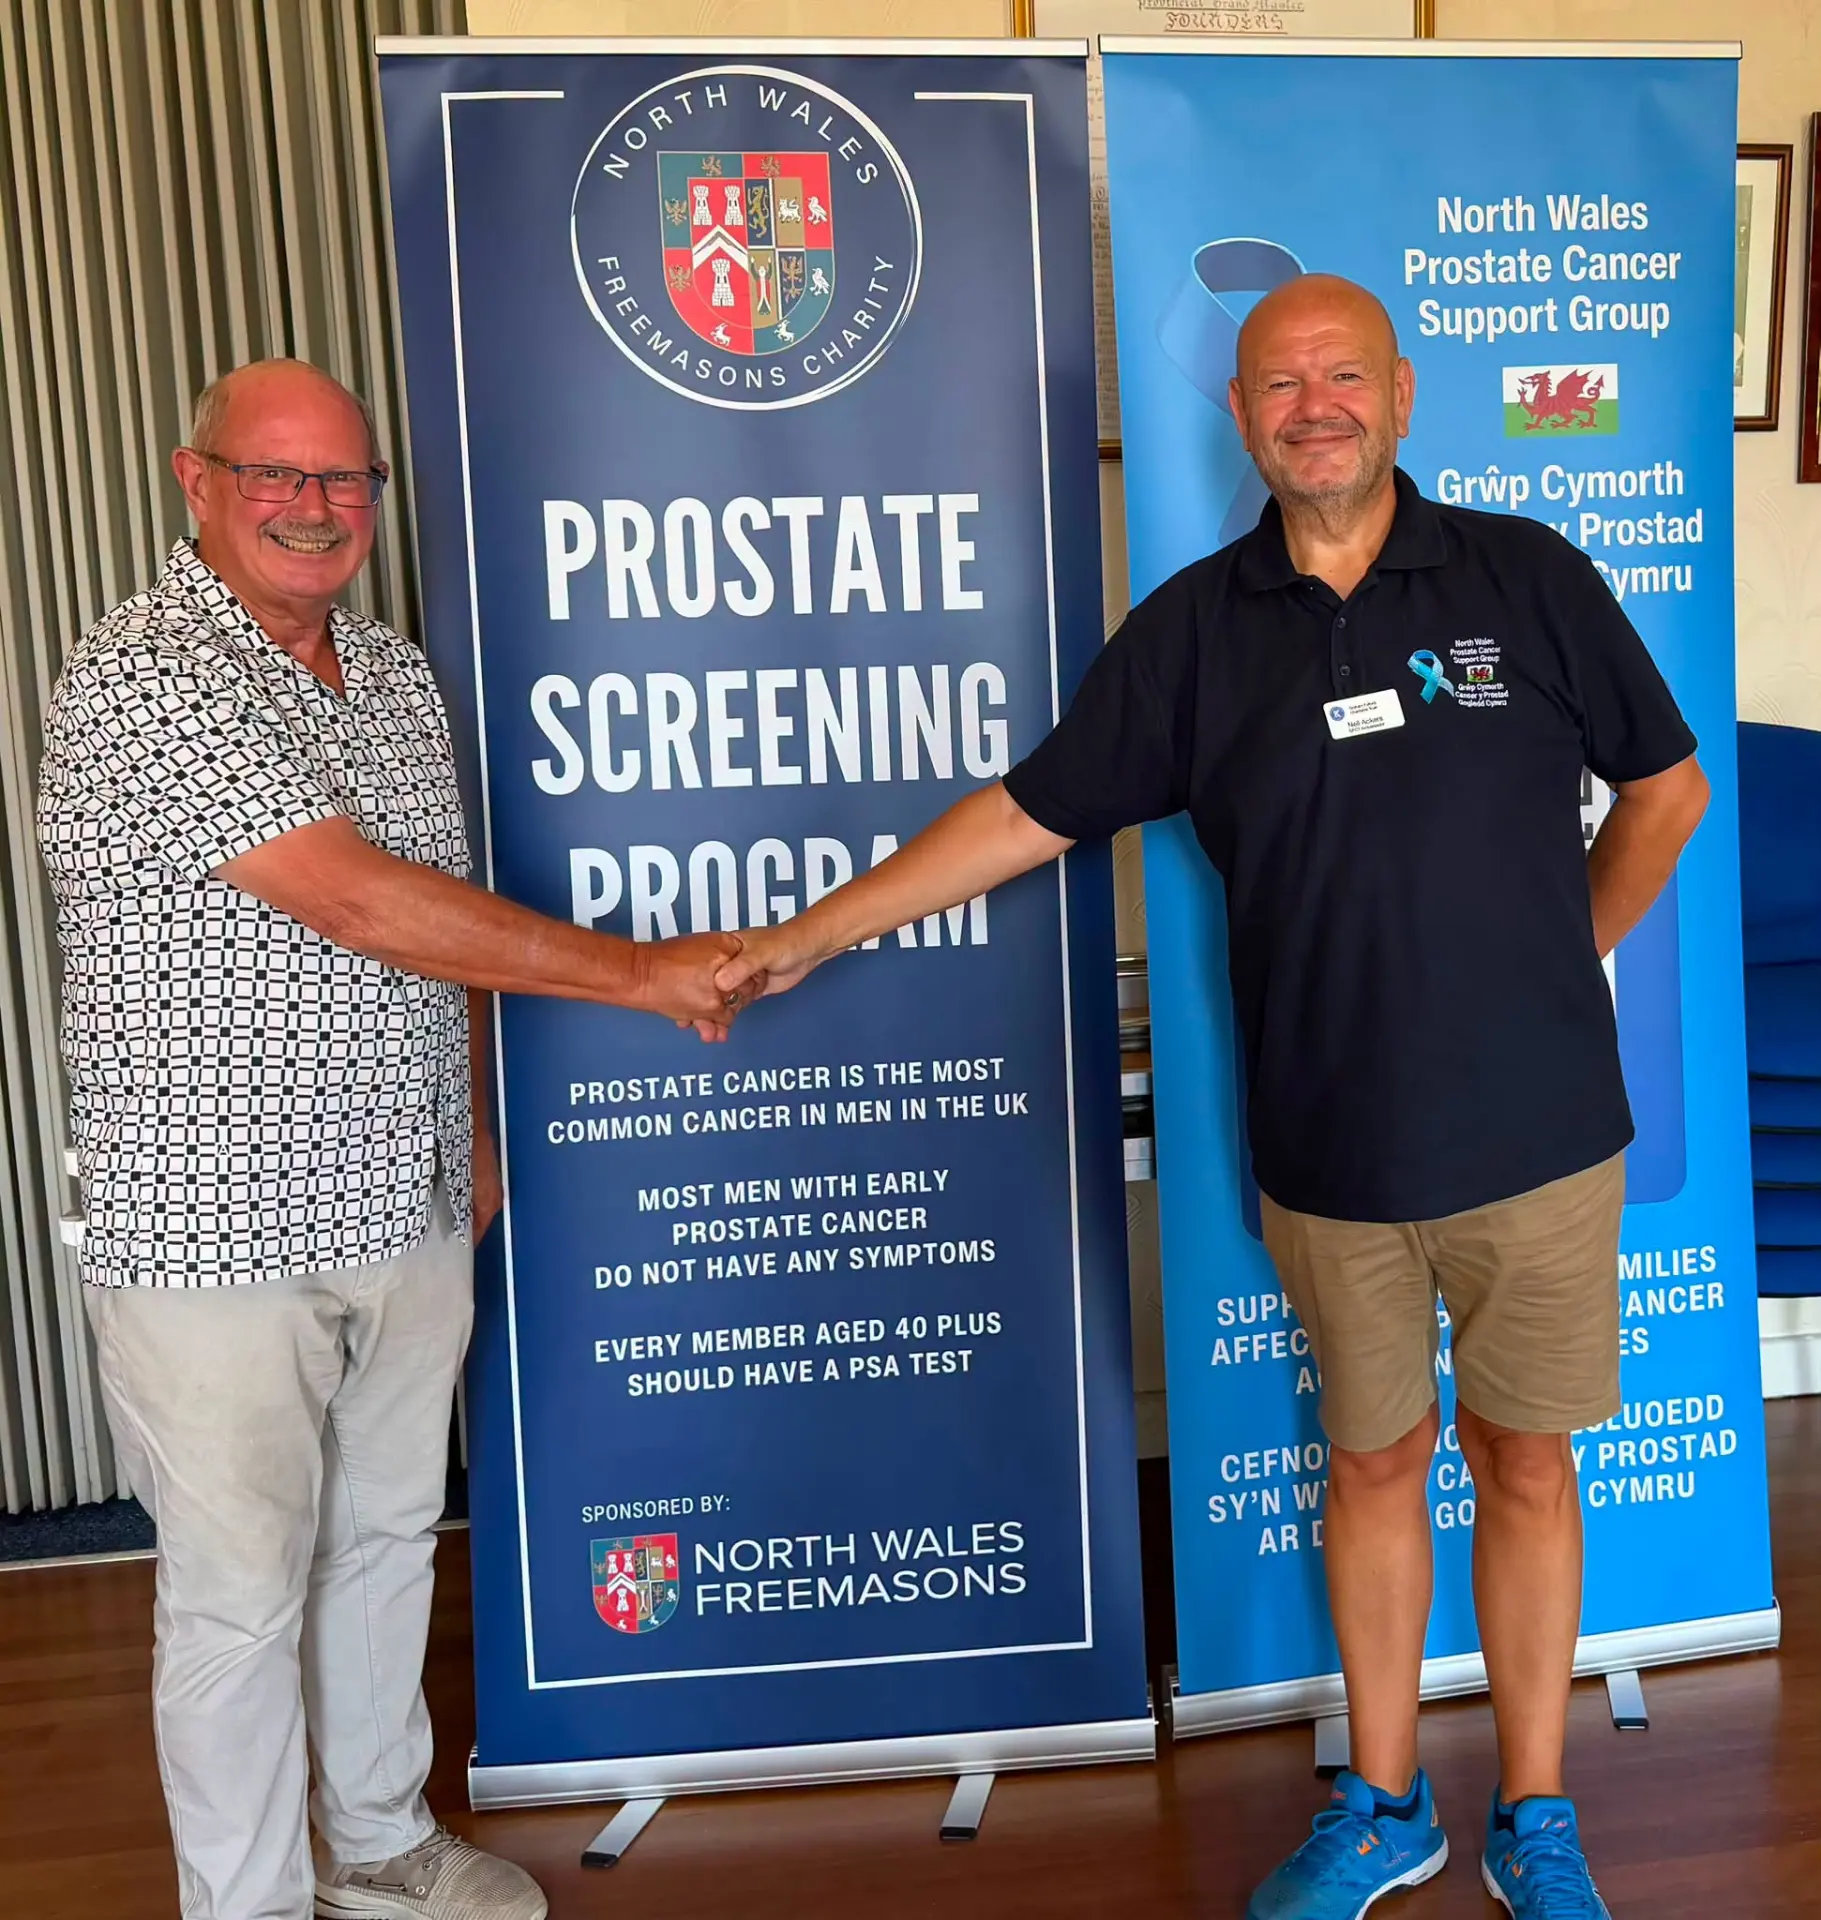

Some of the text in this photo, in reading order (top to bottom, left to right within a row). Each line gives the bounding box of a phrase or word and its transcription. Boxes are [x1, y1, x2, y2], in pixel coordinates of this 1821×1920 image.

[603, 84, 878, 184] NORTH WALES
[1438, 194, 1649, 234] North Wales
[1404, 244, 1682, 285] Prostate Cancer
[597, 255, 894, 389] FREEMASONS CHARITY
[1418, 295, 1670, 344] Support Group
[1437, 460, 1684, 511] Grŵp Cymorth
[1579, 508, 1703, 548] Prostad
[543, 493, 984, 620] PROSTATE
[530, 661, 1010, 796] SCREENING
[570, 1057, 1004, 1106] PROSTATE CANCER IS THE MOST
[547, 1092, 1029, 1144] COMMON CANCER IN MEN IN THE UK
[638, 1169, 949, 1212] MOST MEN WITH EARLY
[672, 1207, 927, 1246] PROSTATE CANCER
[595, 1239, 996, 1289] DO NOT HAVE ANY SYMPTOMS
[1619, 1282, 1724, 1318] ANCER
[595, 1311, 1002, 1363] EVERY MEMBER AGED 40 PLUS
[627, 1349, 973, 1397] SHOULD HAVE A PSA TEST
[1221, 1394, 1724, 1483] CEFNO LUOEDD
[1598, 1429, 1737, 1469] PROSTAD
[582, 1494, 730, 1523] SPONSORED BY:
[1258, 1524, 1299, 1555] AR
[1588, 1471, 1695, 1508] CYMRU
[695, 1521, 1024, 1575] NORTH WALES
[696, 1562, 1026, 1616] FREEMASONS
